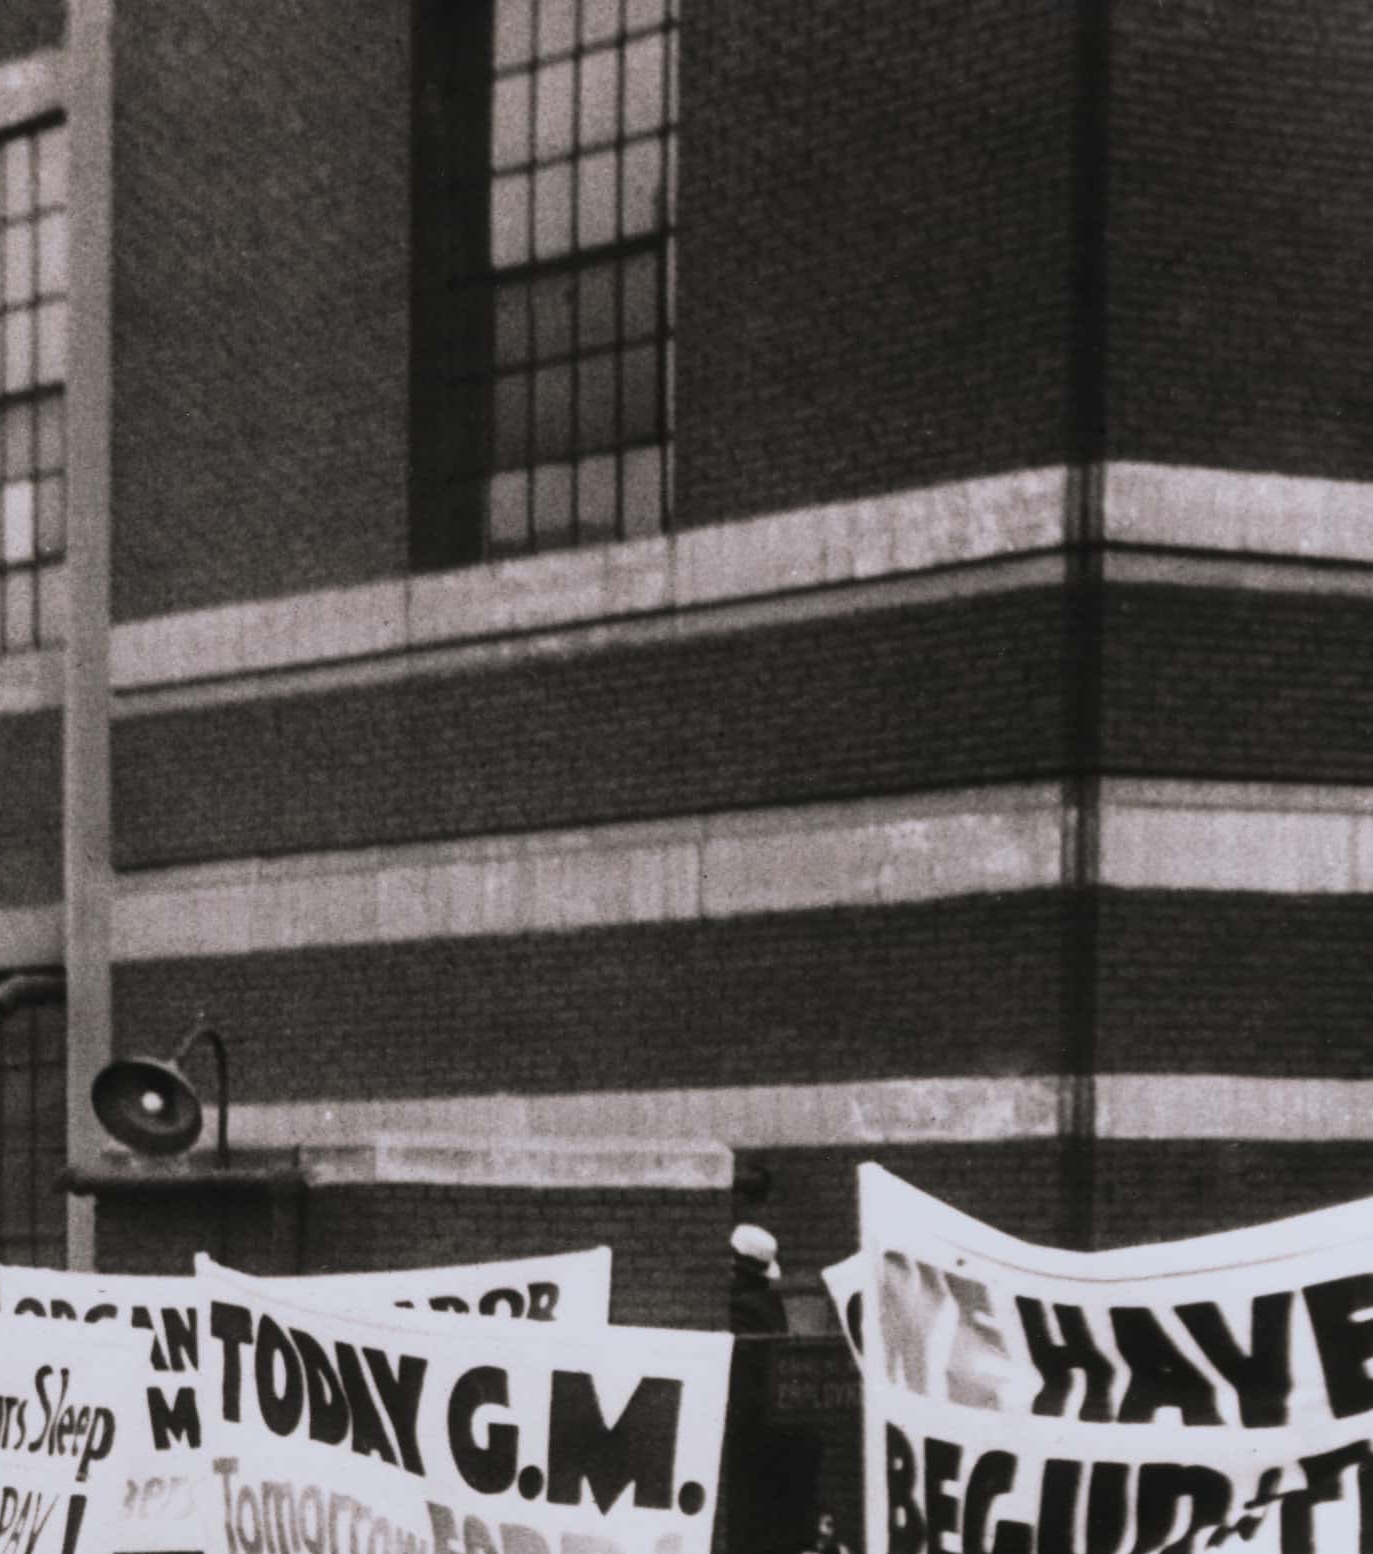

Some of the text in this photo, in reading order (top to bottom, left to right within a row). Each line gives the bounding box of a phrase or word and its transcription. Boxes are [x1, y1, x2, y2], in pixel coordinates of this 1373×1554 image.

[27, 1364, 116, 1483] Sleep
[210, 1300, 428, 1477] TODAY
[447, 1364, 706, 1516] G.M.
[1014, 1272, 1373, 1428] HAVE
